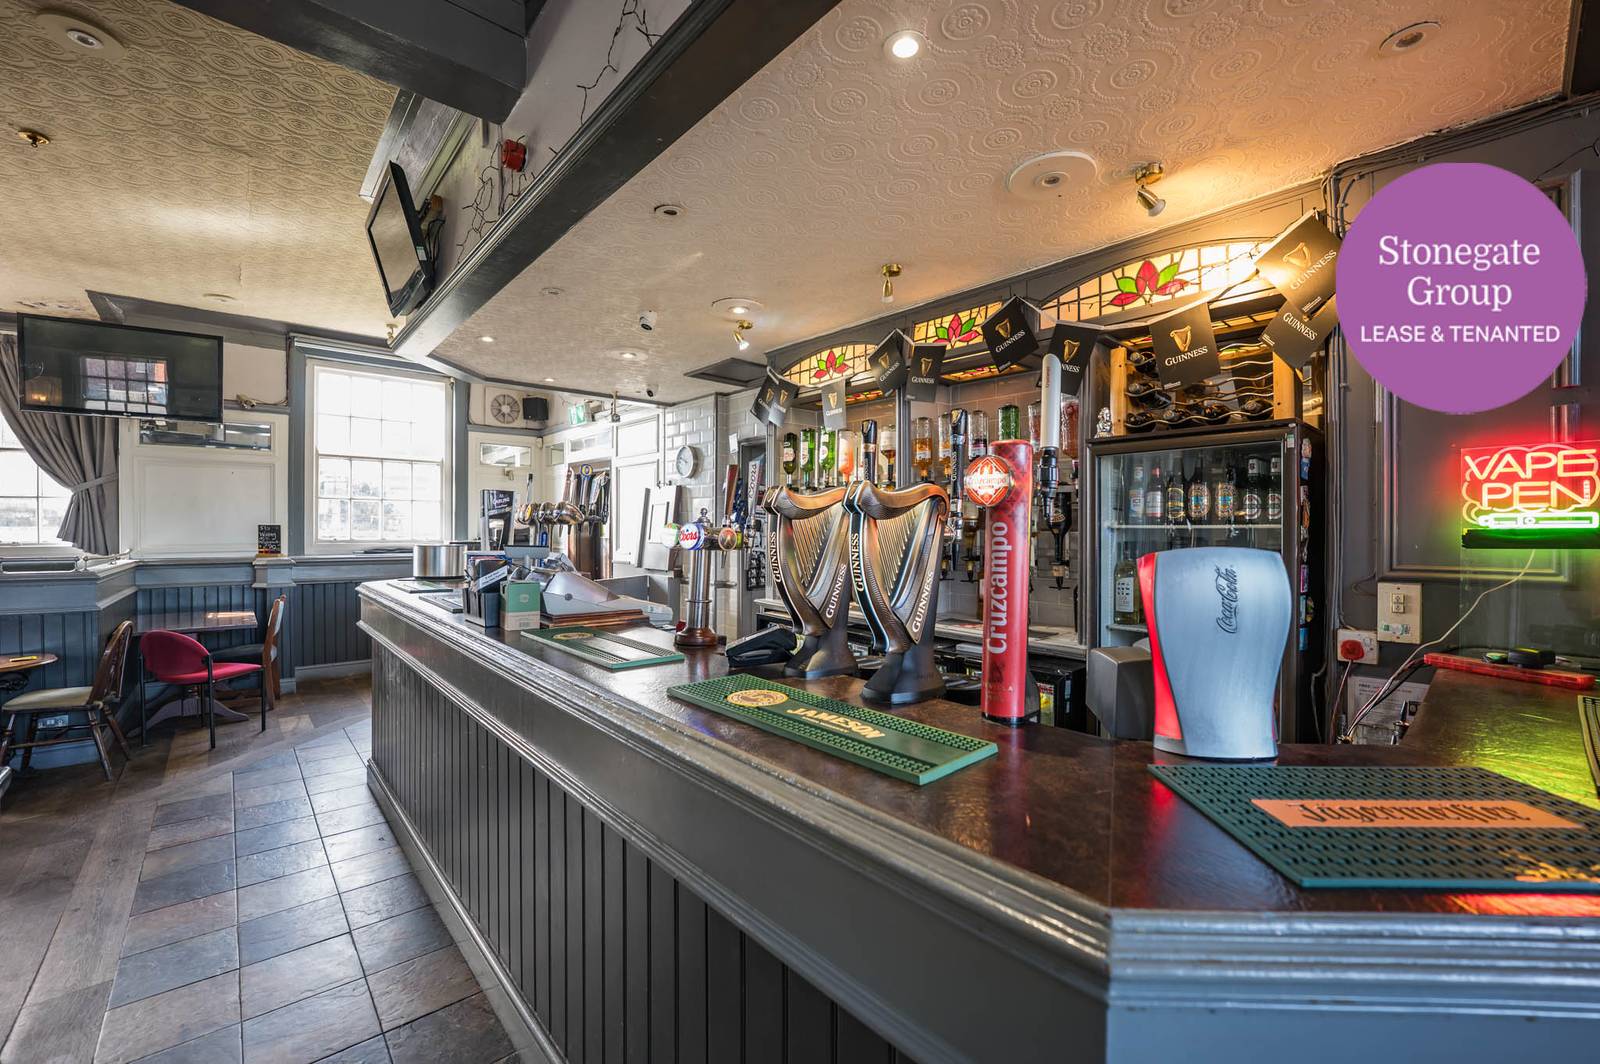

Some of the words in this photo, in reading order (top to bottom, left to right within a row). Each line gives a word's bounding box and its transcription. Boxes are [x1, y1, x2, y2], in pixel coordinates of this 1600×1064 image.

[1290, 249, 1337, 290] GUINNESS
[995, 330, 1026, 353] GUINNESS
[1283, 312, 1318, 341] GUINNESS
[1061, 362, 1081, 374] NNESS
[1165, 346, 1208, 367] GUINNESS
[911, 376, 935, 385] GUINNESS
[1465, 449, 1597, 480] VAPE
[1482, 481, 1591, 509] PEN
[680, 530, 699, 542] Coors
[768, 531, 783, 583] GUINNESS
[849, 531, 865, 593] GUINNESS
[826, 564, 847, 619] GUINNESS
[912, 569, 934, 634] GUINNESS
[988, 521, 1012, 655] Cruzcampo
[786, 708, 886, 739] JAMESON
